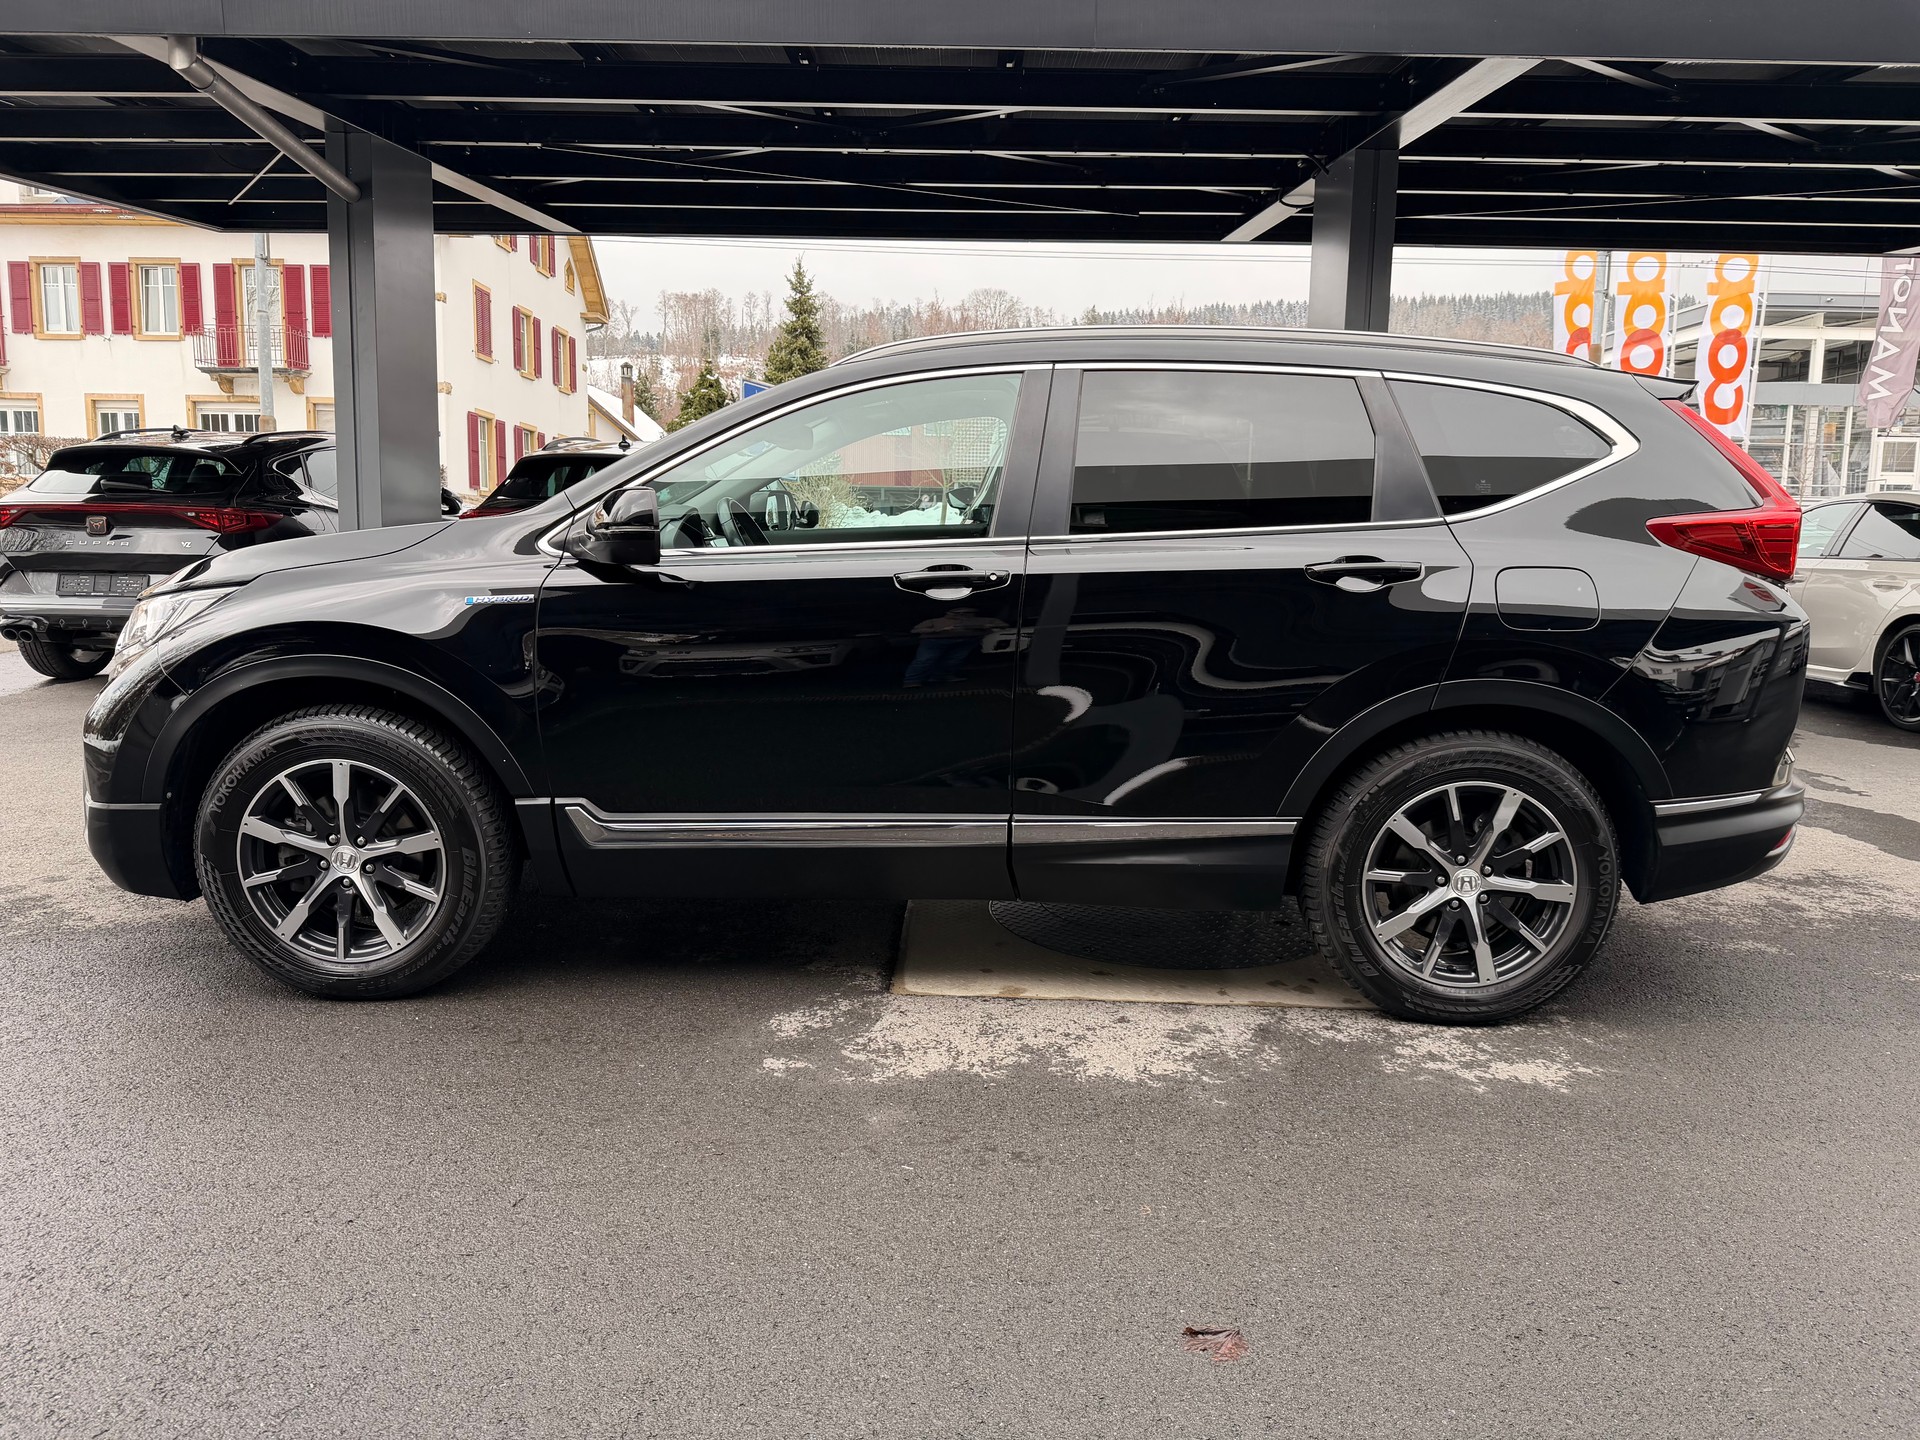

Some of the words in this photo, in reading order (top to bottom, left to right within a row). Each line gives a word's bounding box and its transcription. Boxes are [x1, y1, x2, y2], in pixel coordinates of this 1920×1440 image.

[474, 595, 530, 604] HYBRID
[208, 743, 277, 815] YOKOHAMA
[441, 846, 478, 946] BluEarth
[1584, 850, 1612, 944] YOKOHAMA
